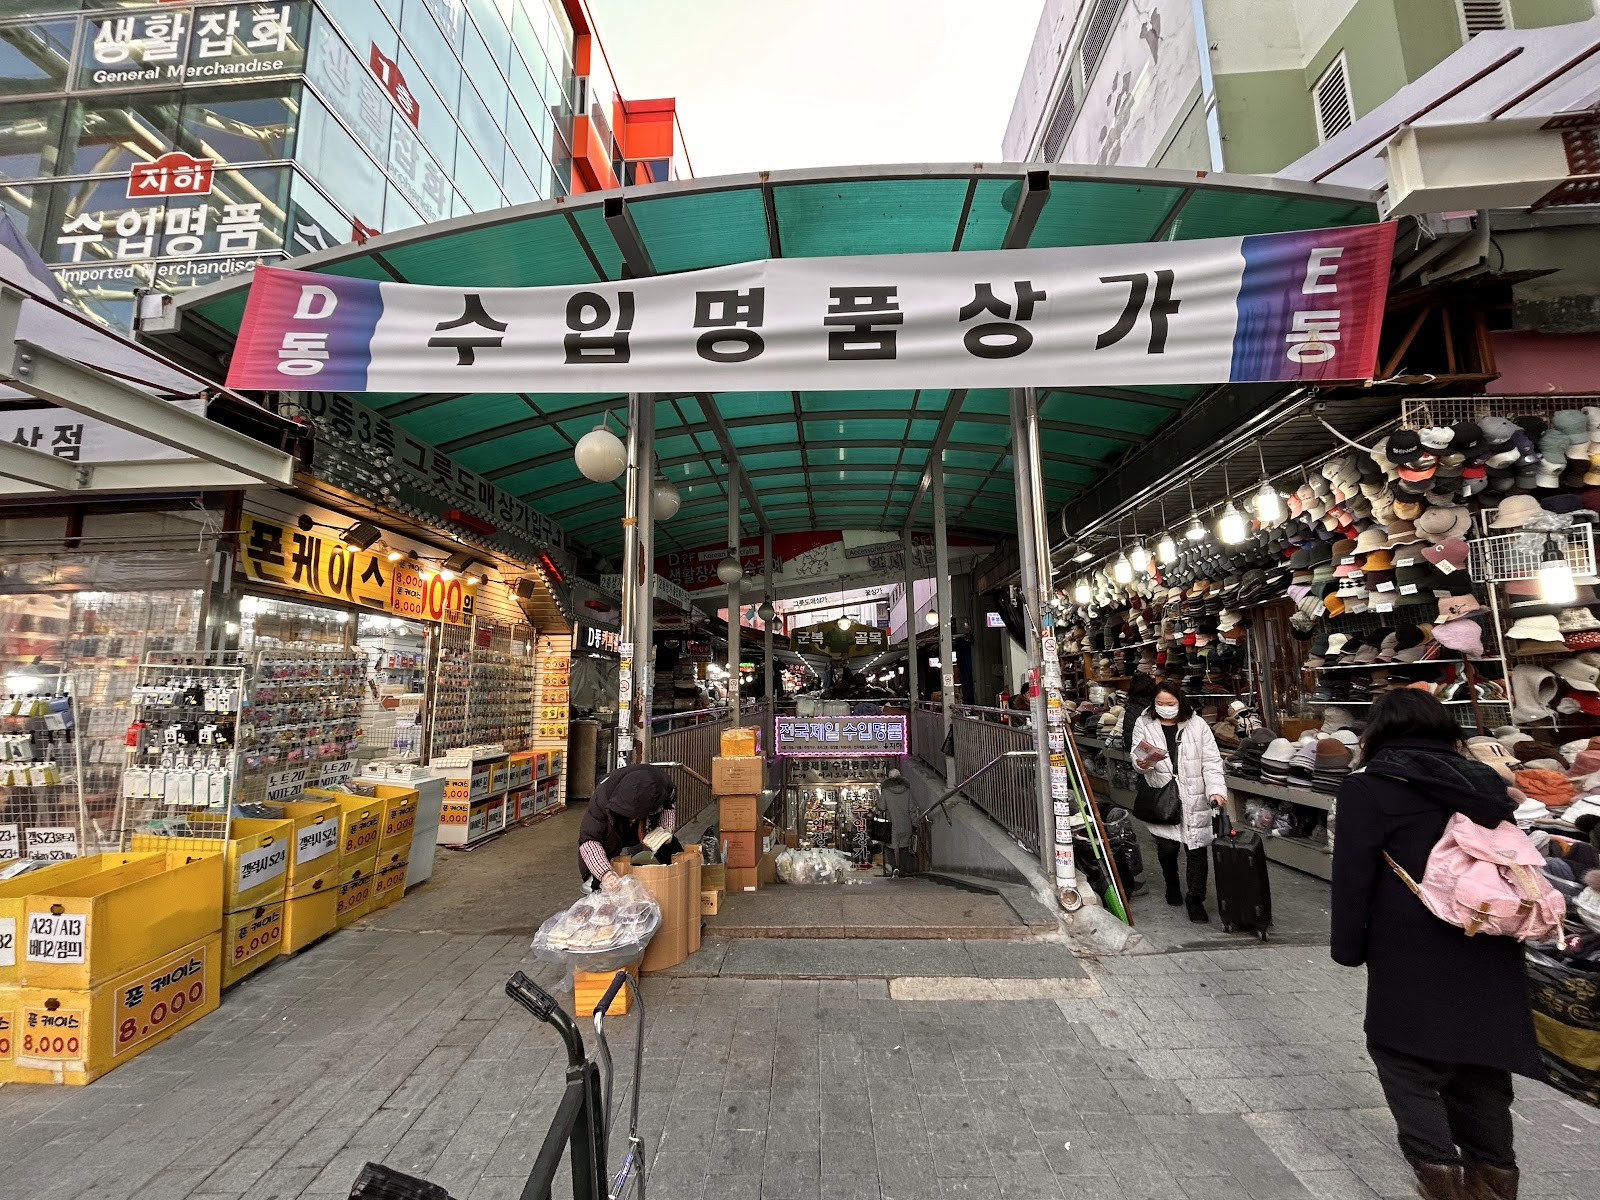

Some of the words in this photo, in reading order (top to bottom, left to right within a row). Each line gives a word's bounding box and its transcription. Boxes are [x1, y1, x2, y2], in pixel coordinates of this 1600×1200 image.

[94, 5, 292, 64] 생활잡화
[93, 66, 160, 83] General
[167, 58, 283, 79] Merchandise
[139, 165, 204, 191] 지하
[57, 203, 264, 263] 수입명품
[62, 264, 134, 283] Imported
[428, 269, 1180, 366] 수입명품상가
[668, 553, 679, 566] D
[703, 551, 726, 560] Korean
[849, 545, 886, 556] Accessories
[250, 519, 384, 608] 폰케이스
[797, 631, 824, 645] 군복
[854, 631, 881, 645] 골목
[779, 722, 840, 742] 전국제일
[842, 722, 903, 742] 수입명품
[386, 817, 414, 834] 8,000
[440, 814, 468, 823] 8,000
[299, 831, 322, 851] 갤럭시
[323, 826, 337, 841] S24
[346, 830, 377, 851] 8,000
[242, 857, 267, 879] 갤럭시
[269, 850, 286, 867] S24
[251, 912, 280, 931] 케이스
[235, 926, 280, 959] 8,000
[124, 984, 144, 1008] 폰
[150, 958, 202, 993] 케이스
[28, 1012, 38, 1027] 폰
[41, 1014, 79, 1030] 케이스
[119, 981, 203, 1043] 8,000
[24, 1034, 79, 1053] 8,000
